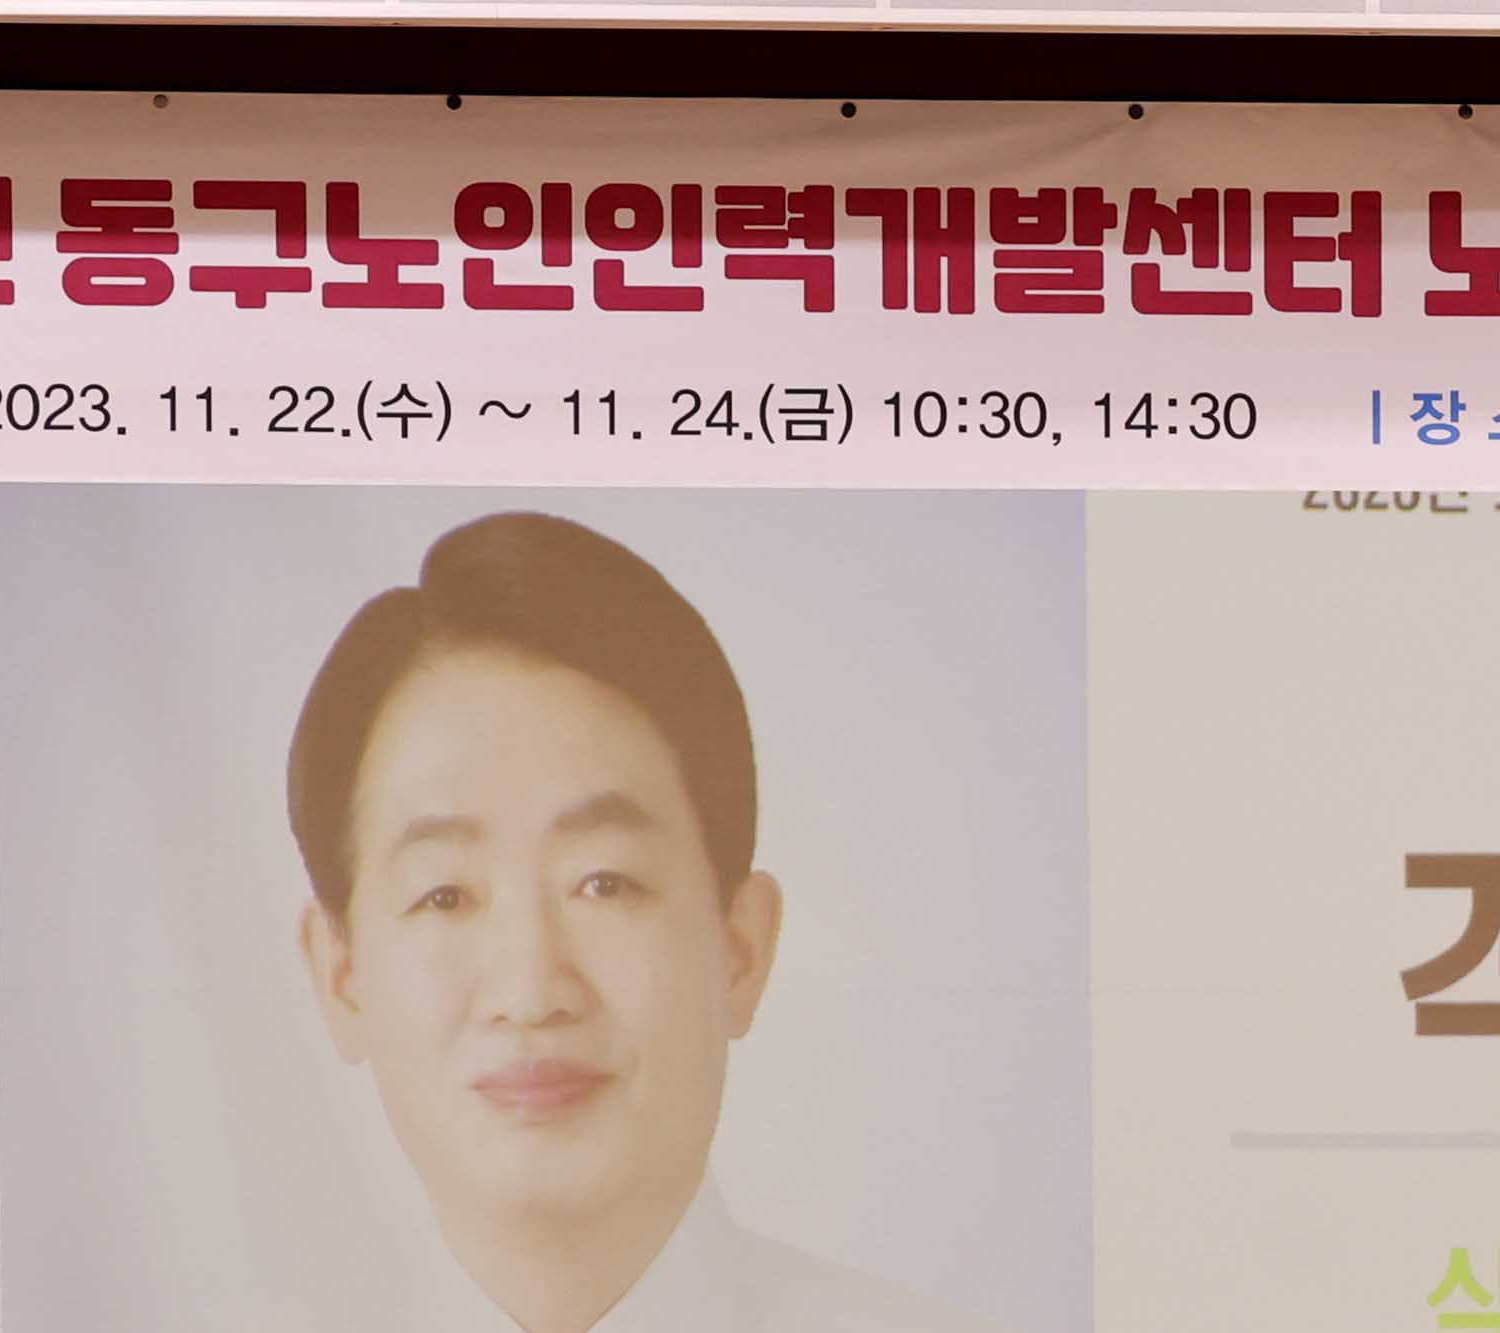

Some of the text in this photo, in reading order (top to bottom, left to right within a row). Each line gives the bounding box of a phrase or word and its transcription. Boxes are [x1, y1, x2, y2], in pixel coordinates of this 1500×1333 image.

[57, 179, 1381, 317] 동구노인인력개발센터
[160, 386, 239, 436] 11.
[268, 380, 451, 442] 22.(수)
[564, 389, 641, 440] 11.
[671, 384, 853, 444] 24.(금)
[884, 391, 1061, 446] 10:30,
[1094, 392, 1257, 440] 14:30
